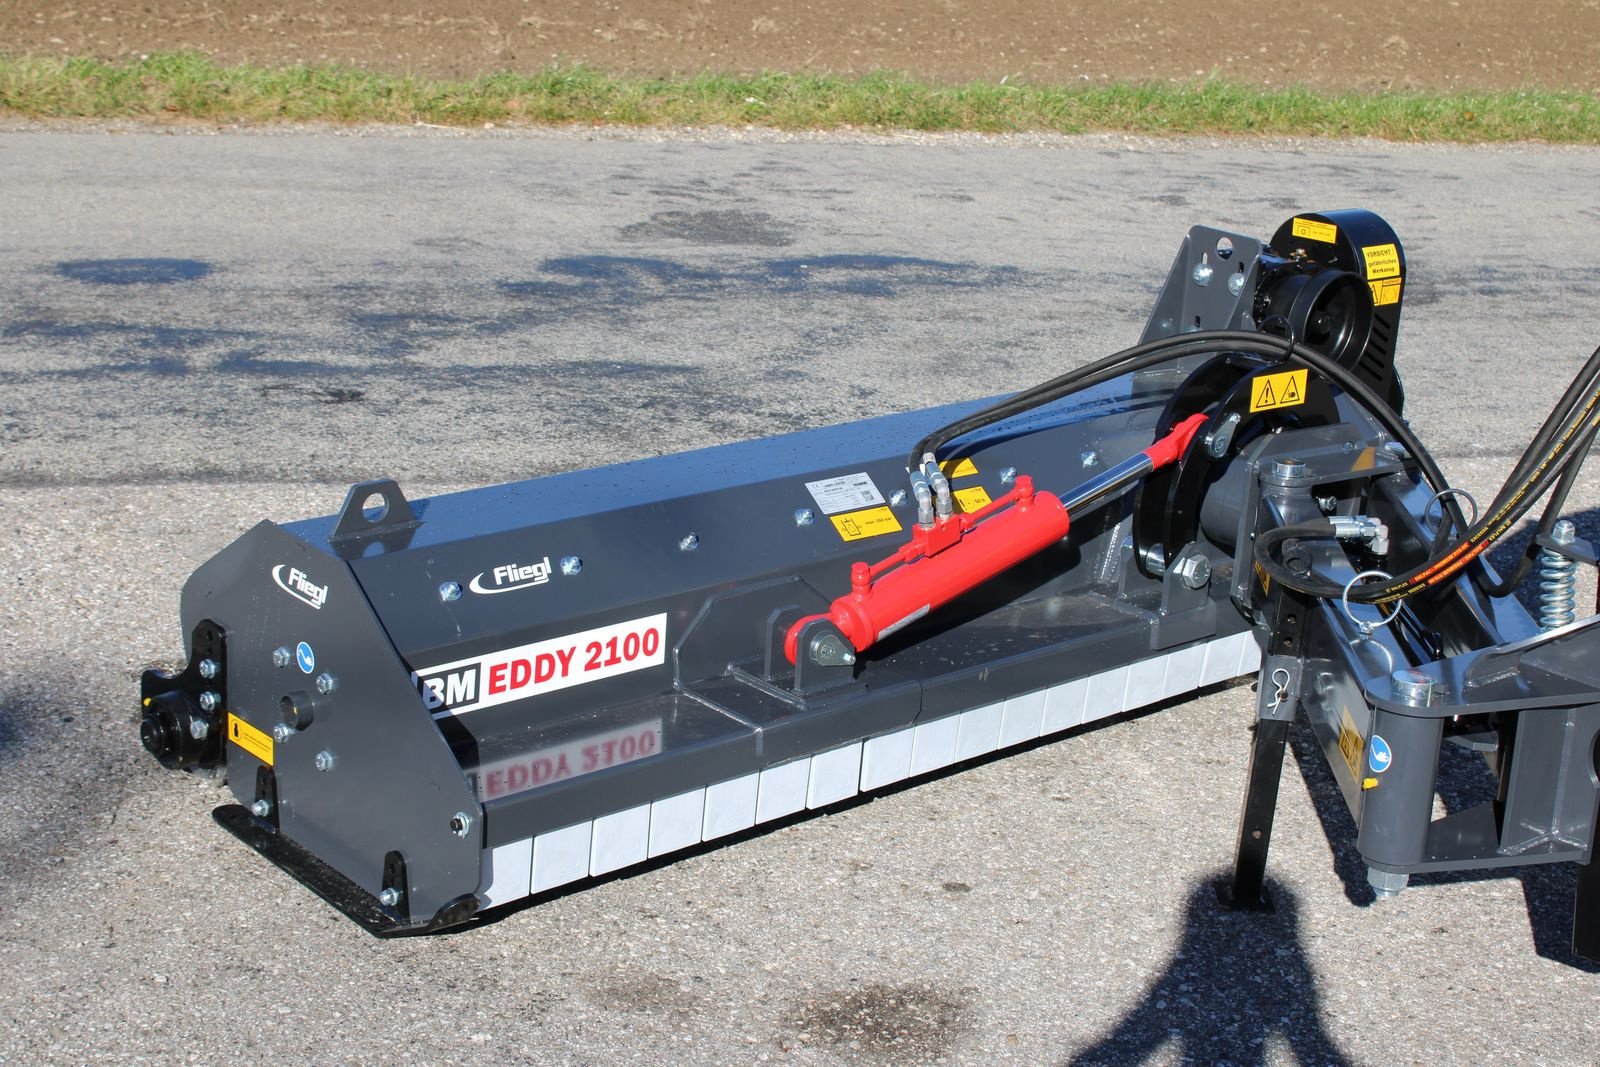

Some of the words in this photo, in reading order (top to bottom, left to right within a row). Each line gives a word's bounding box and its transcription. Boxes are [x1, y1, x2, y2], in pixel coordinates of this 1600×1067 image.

[288, 567, 328, 606] Fliegl
[493, 556, 552, 586] Fliegl
[488, 646, 577, 696] EDDY
[584, 627, 660, 672] 2100
